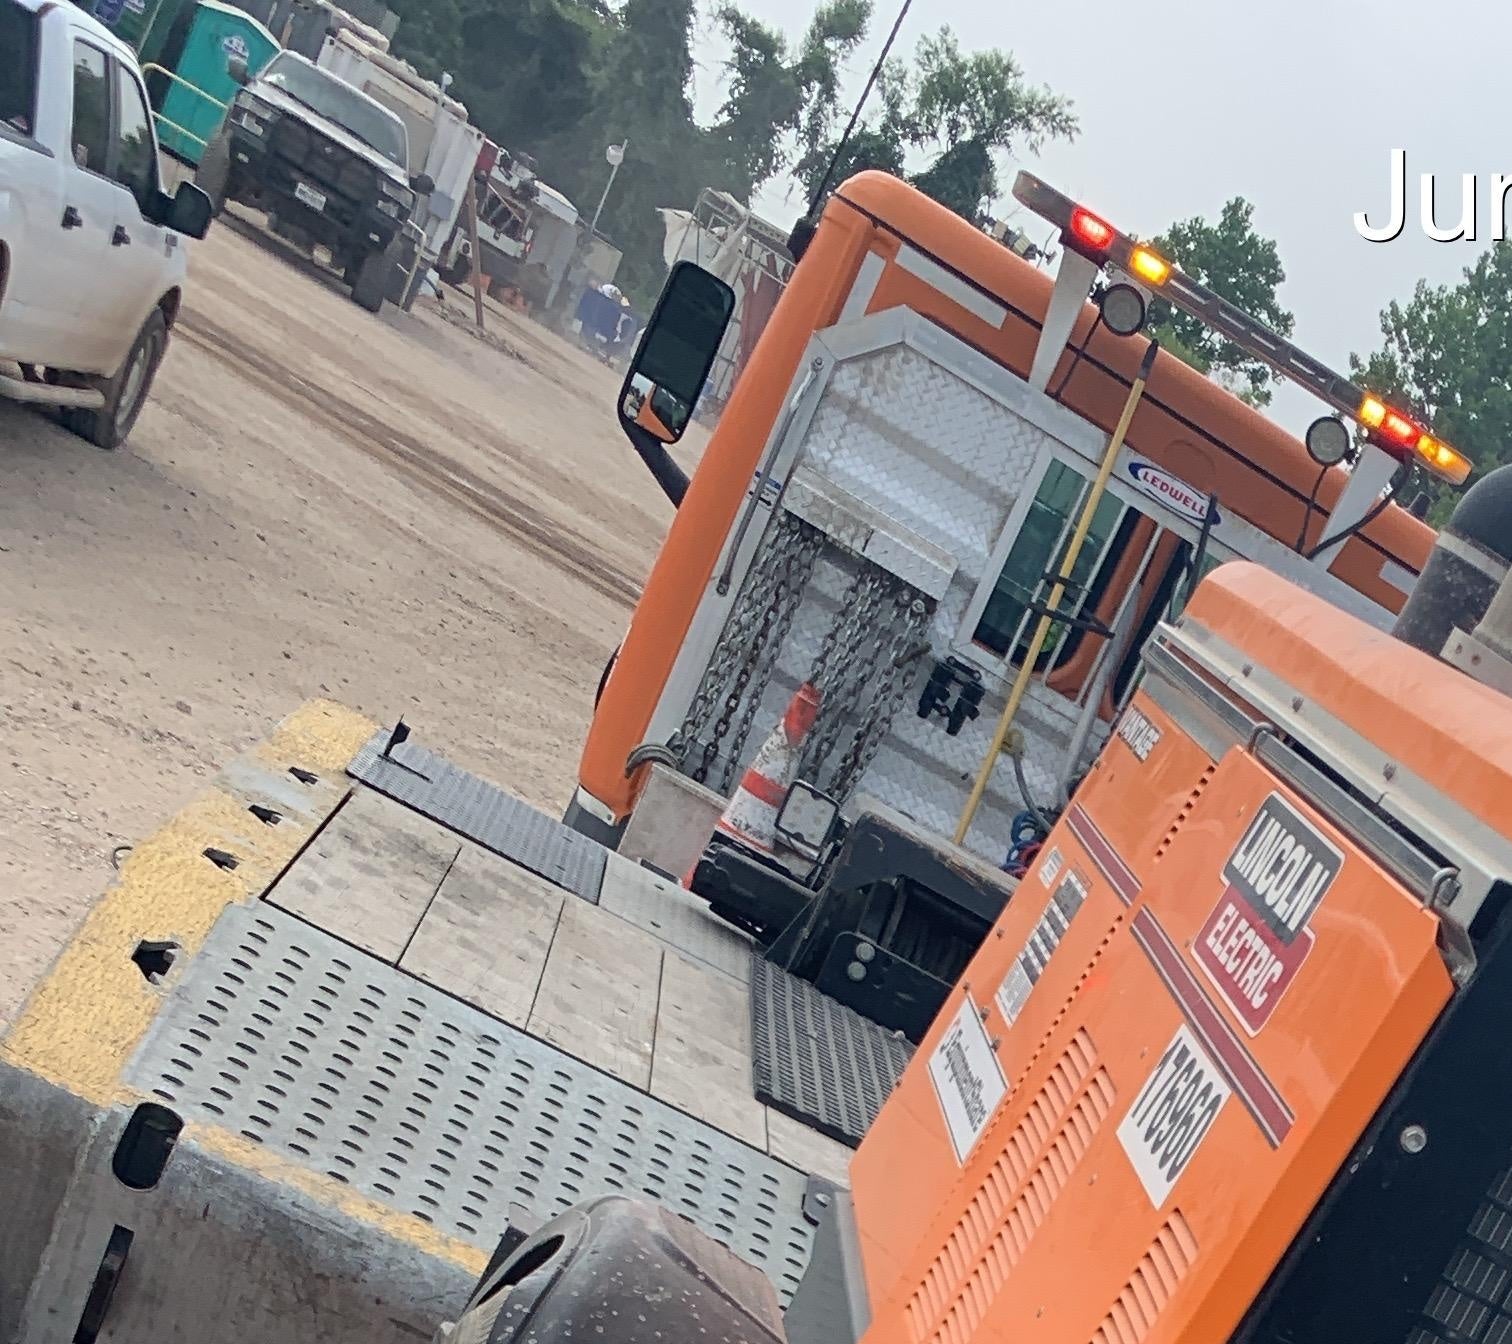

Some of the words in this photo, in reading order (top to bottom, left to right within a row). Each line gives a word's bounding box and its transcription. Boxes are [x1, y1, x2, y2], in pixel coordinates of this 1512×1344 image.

[1142, 470, 1207, 518] LEDWELL
[1231, 809, 1331, 932] LINCOLN
[1204, 902, 1285, 1011] ELECTRIC
[1131, 1036, 1223, 1184] 176960
